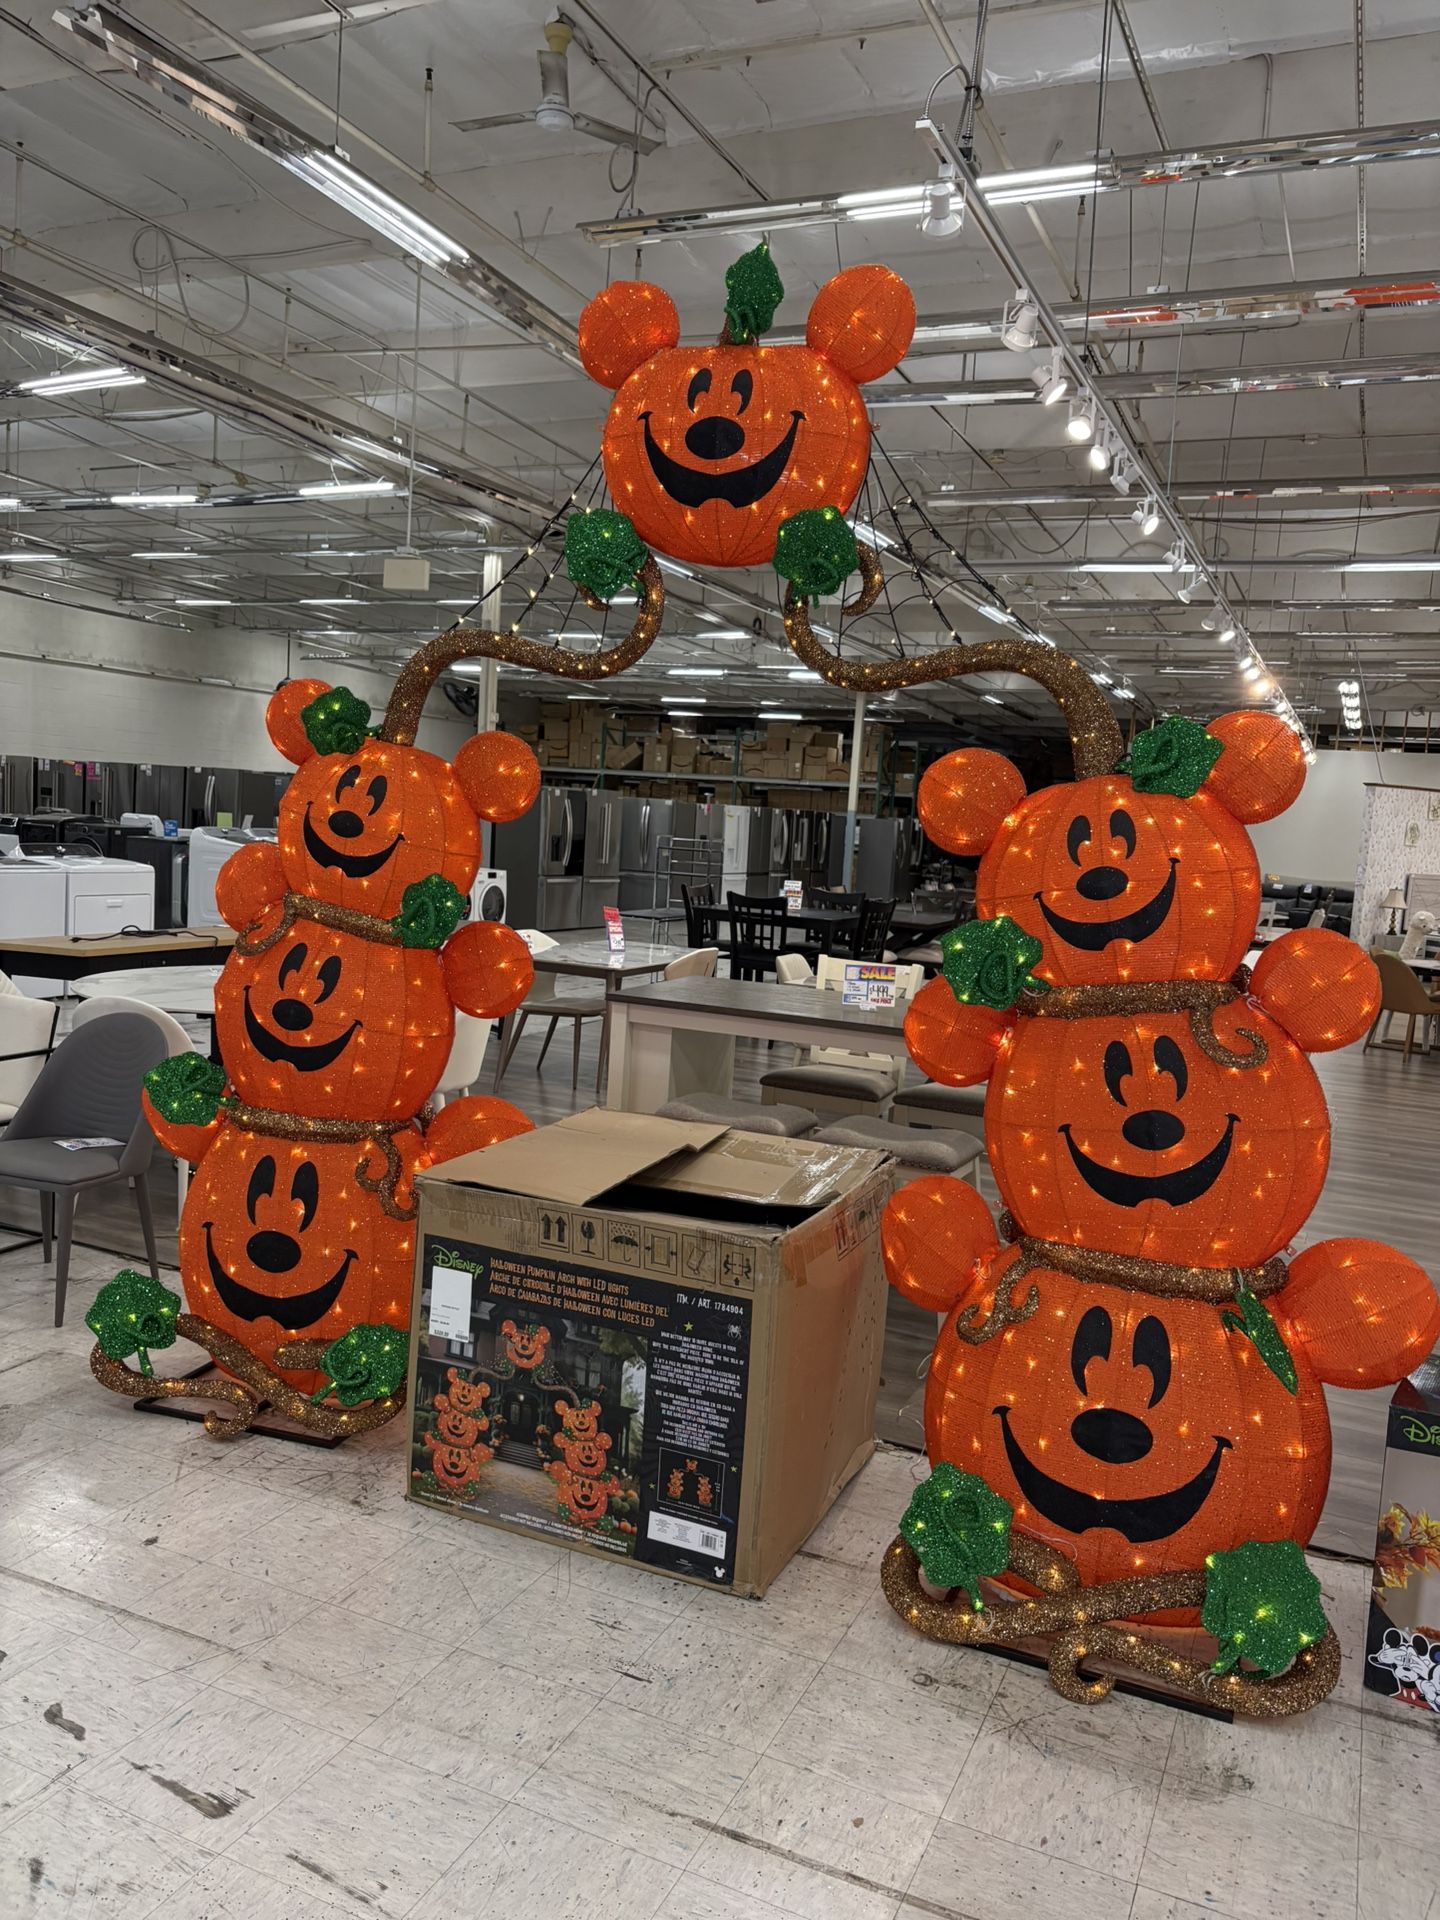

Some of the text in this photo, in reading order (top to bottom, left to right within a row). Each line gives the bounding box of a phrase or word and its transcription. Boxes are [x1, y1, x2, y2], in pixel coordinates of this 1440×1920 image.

[859, 965, 896, 981] SALE
[431, 1244, 484, 1279] Disney
[490, 1257, 629, 1296] HALLOWEEN PUMPKIN ARCH WITH LED LIGHTS
[489, 1269, 511, 1284] ARCHE
[512, 1275, 521, 1286] DE
[601, 1294, 619, 1307] AVEC
[655, 1305, 669, 1317] DEL
[489, 1282, 506, 1295] ARCO
[507, 1287, 516, 1298] DE
[553, 1297, 562, 1308] DE
[563, 1298, 601, 1316] HALLOWEEN
[602, 1308, 616, 1320] CON
[617, 1311, 640, 1325] LUCES
[641, 1316, 655, 1327] LED
[714, 1302, 743, 1315] 1784904
